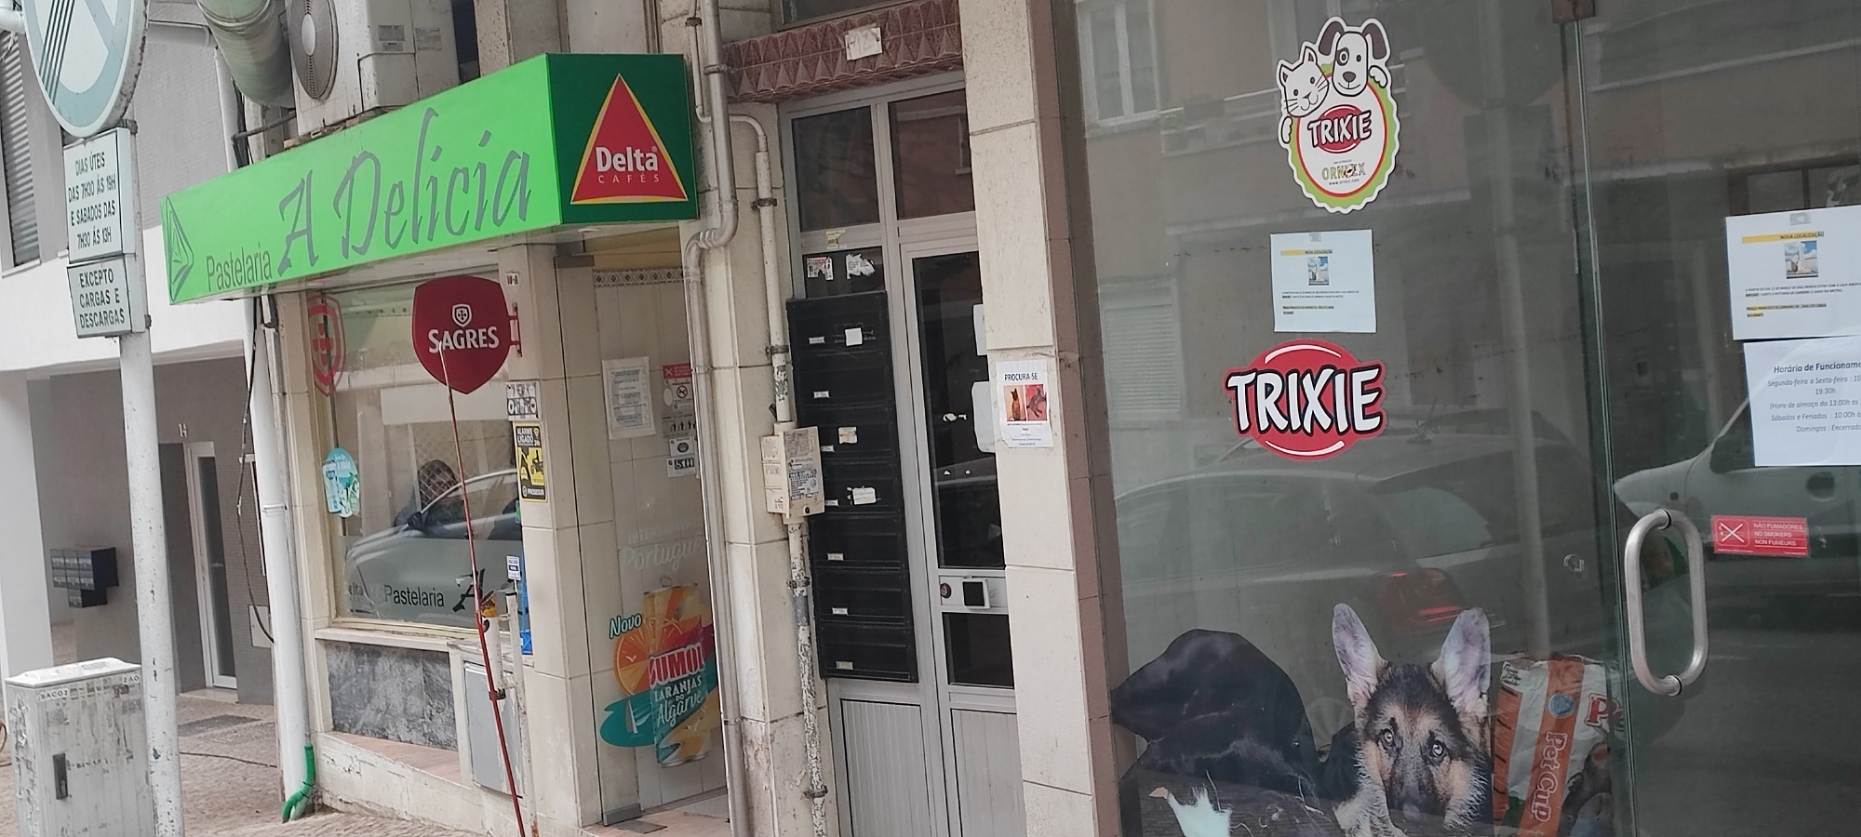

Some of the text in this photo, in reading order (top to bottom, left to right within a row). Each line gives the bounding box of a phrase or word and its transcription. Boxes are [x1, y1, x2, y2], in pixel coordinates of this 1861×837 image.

[1307, 109, 1372, 148] TRIXIE
[75, 151, 105, 176] DIAS ÚTEIS
[595, 146, 659, 172] Delta
[598, 172, 659, 184] CAFÉS
[68, 185, 79, 203] DAS
[71, 210, 75, 226] E
[103, 200, 116, 218] DAS
[278, 169, 319, 277] A
[79, 268, 114, 288] EXCEPTO
[206, 242, 273, 292] Pastelaria
[80, 287, 120, 309] CARGAS E
[79, 308, 125, 329] DESCARGAS
[428, 326, 500, 353] SAGRES
[1773, 365, 1803, 373] Horário
[1804, 363, 1814, 371] de
[1227, 365, 1382, 435] TRIXIE
[383, 584, 445, 608] Pastelaria
[609, 613, 642, 639] Novo
[654, 675, 702, 702] LARANJAS
[657, 690, 703, 728] Algarve
